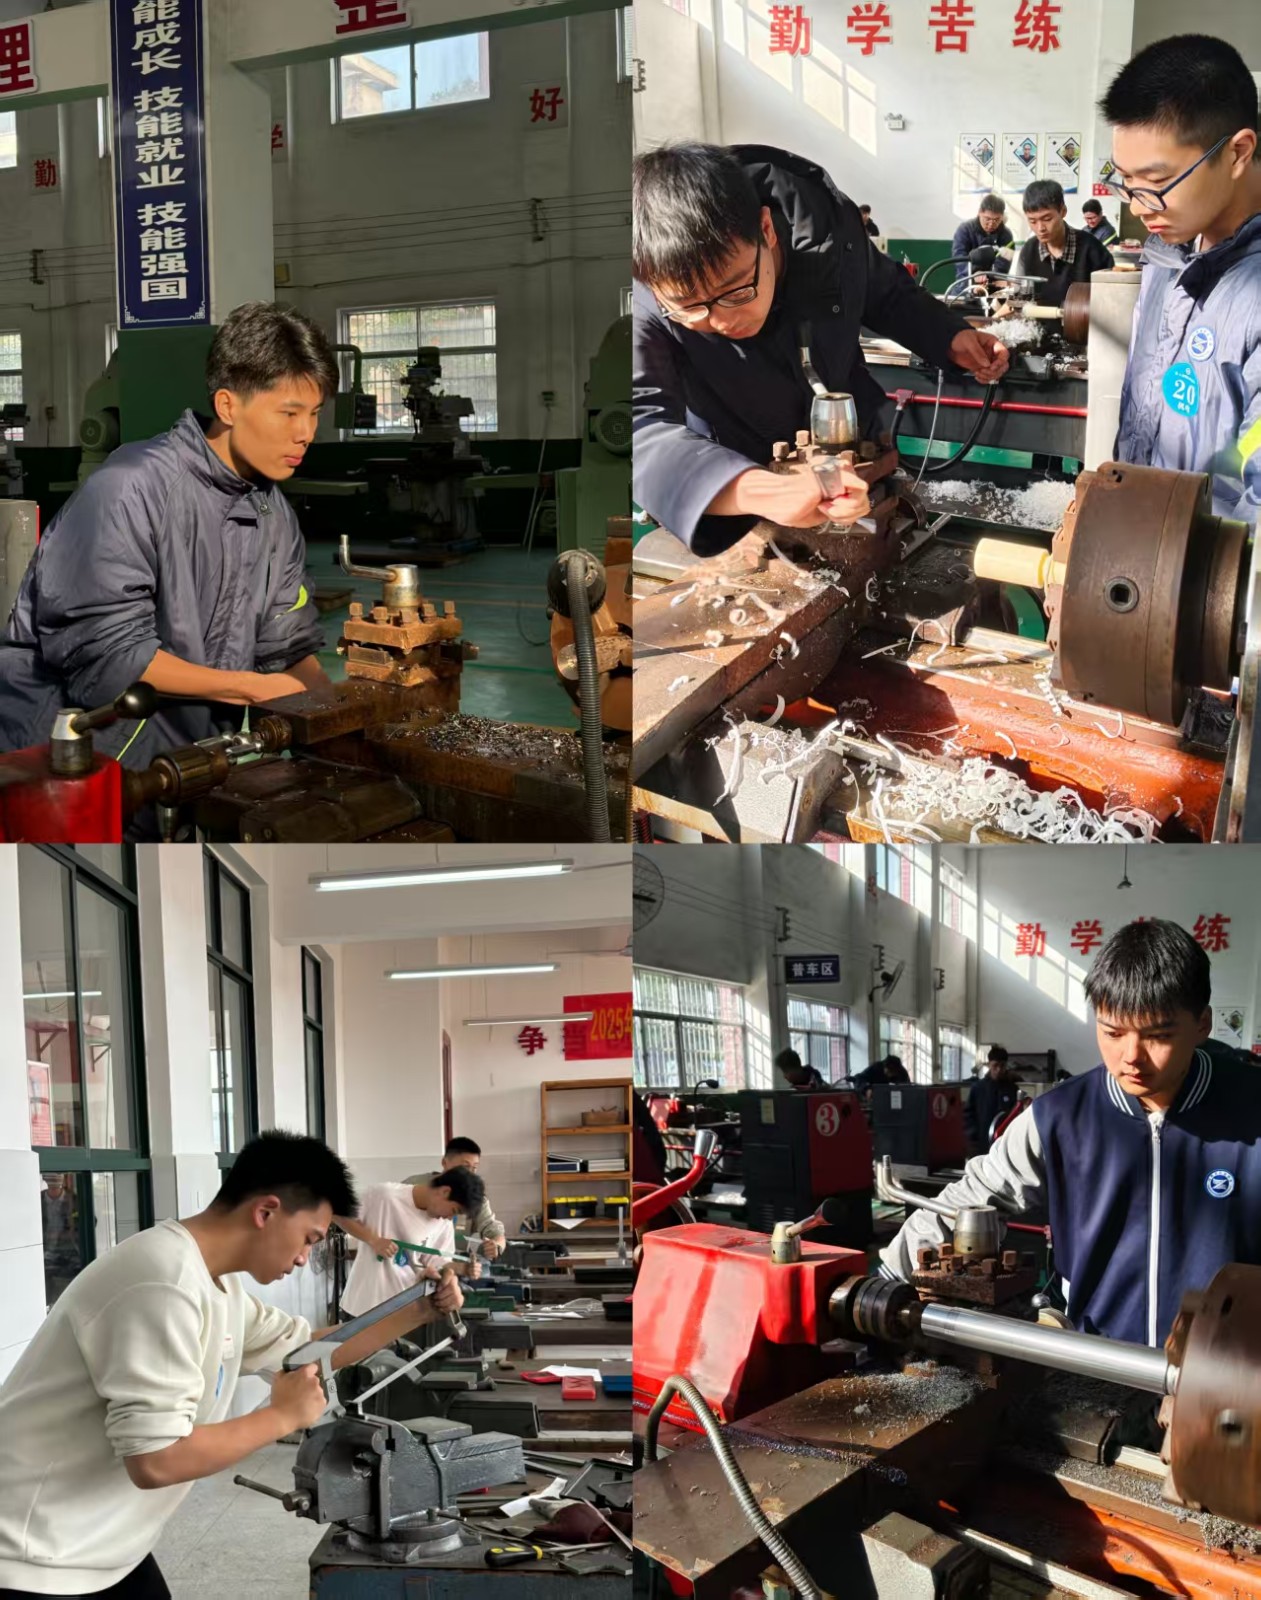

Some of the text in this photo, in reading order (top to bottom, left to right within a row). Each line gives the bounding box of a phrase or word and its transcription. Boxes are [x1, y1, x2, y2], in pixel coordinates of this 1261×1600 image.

[768, 0, 1062, 57] 勤学苦练
[529, 86, 564, 123] 好
[133, 86, 186, 189] 技能就业
[34, 159, 57, 188] 勤
[136, 201, 189, 303] 技能强国
[1172, 379, 1196, 406] 20
[1015, 913, 1231, 958] 勤学练
[792, 961, 834, 977] 普车区
